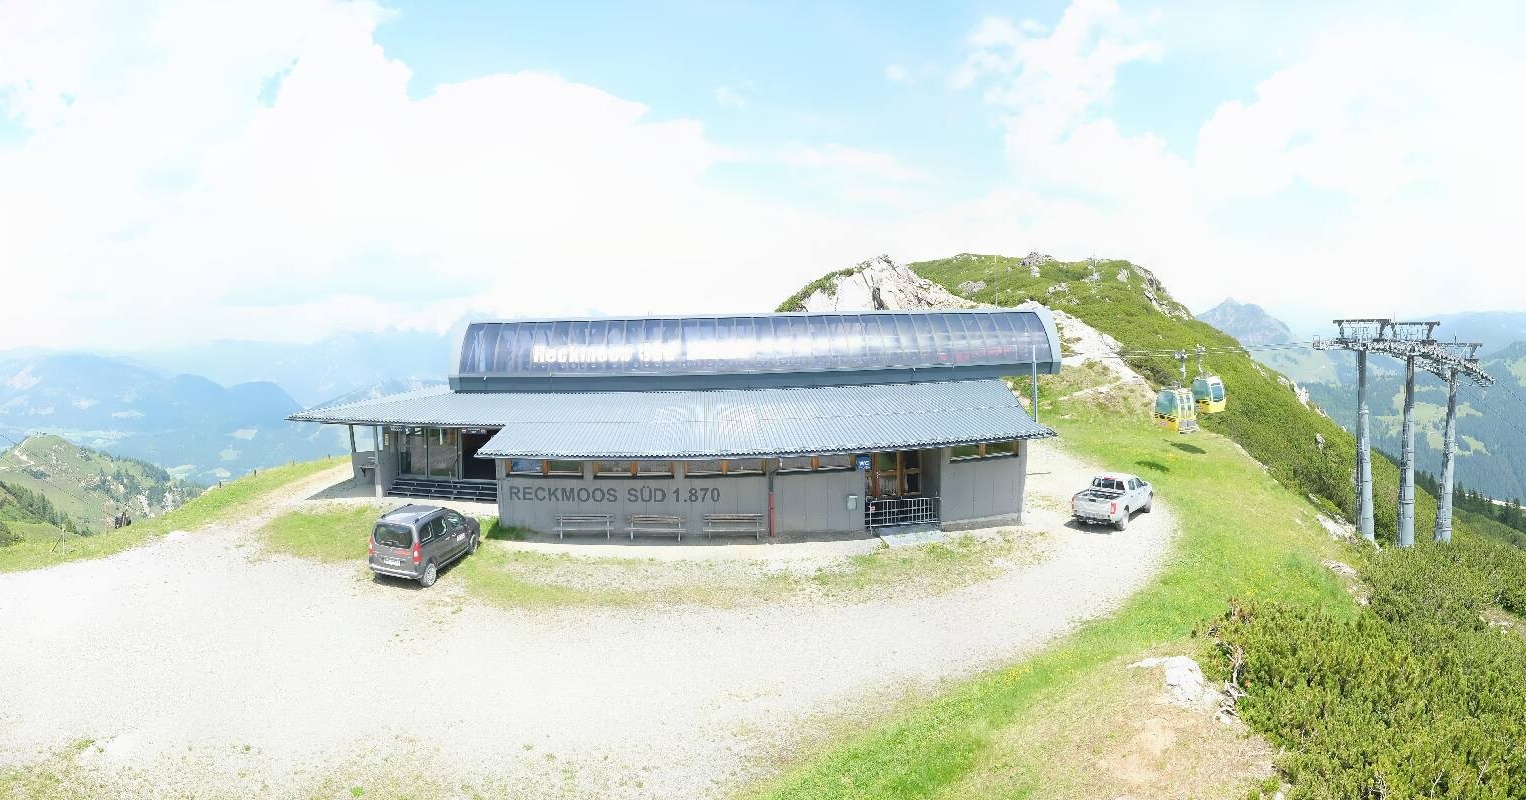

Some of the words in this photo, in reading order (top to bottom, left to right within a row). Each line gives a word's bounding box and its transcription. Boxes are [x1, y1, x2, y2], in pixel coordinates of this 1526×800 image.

[509, 486, 618, 502] RECKMOOS
[627, 484, 667, 503] SÜD
[673, 487, 721, 503] 1.870
